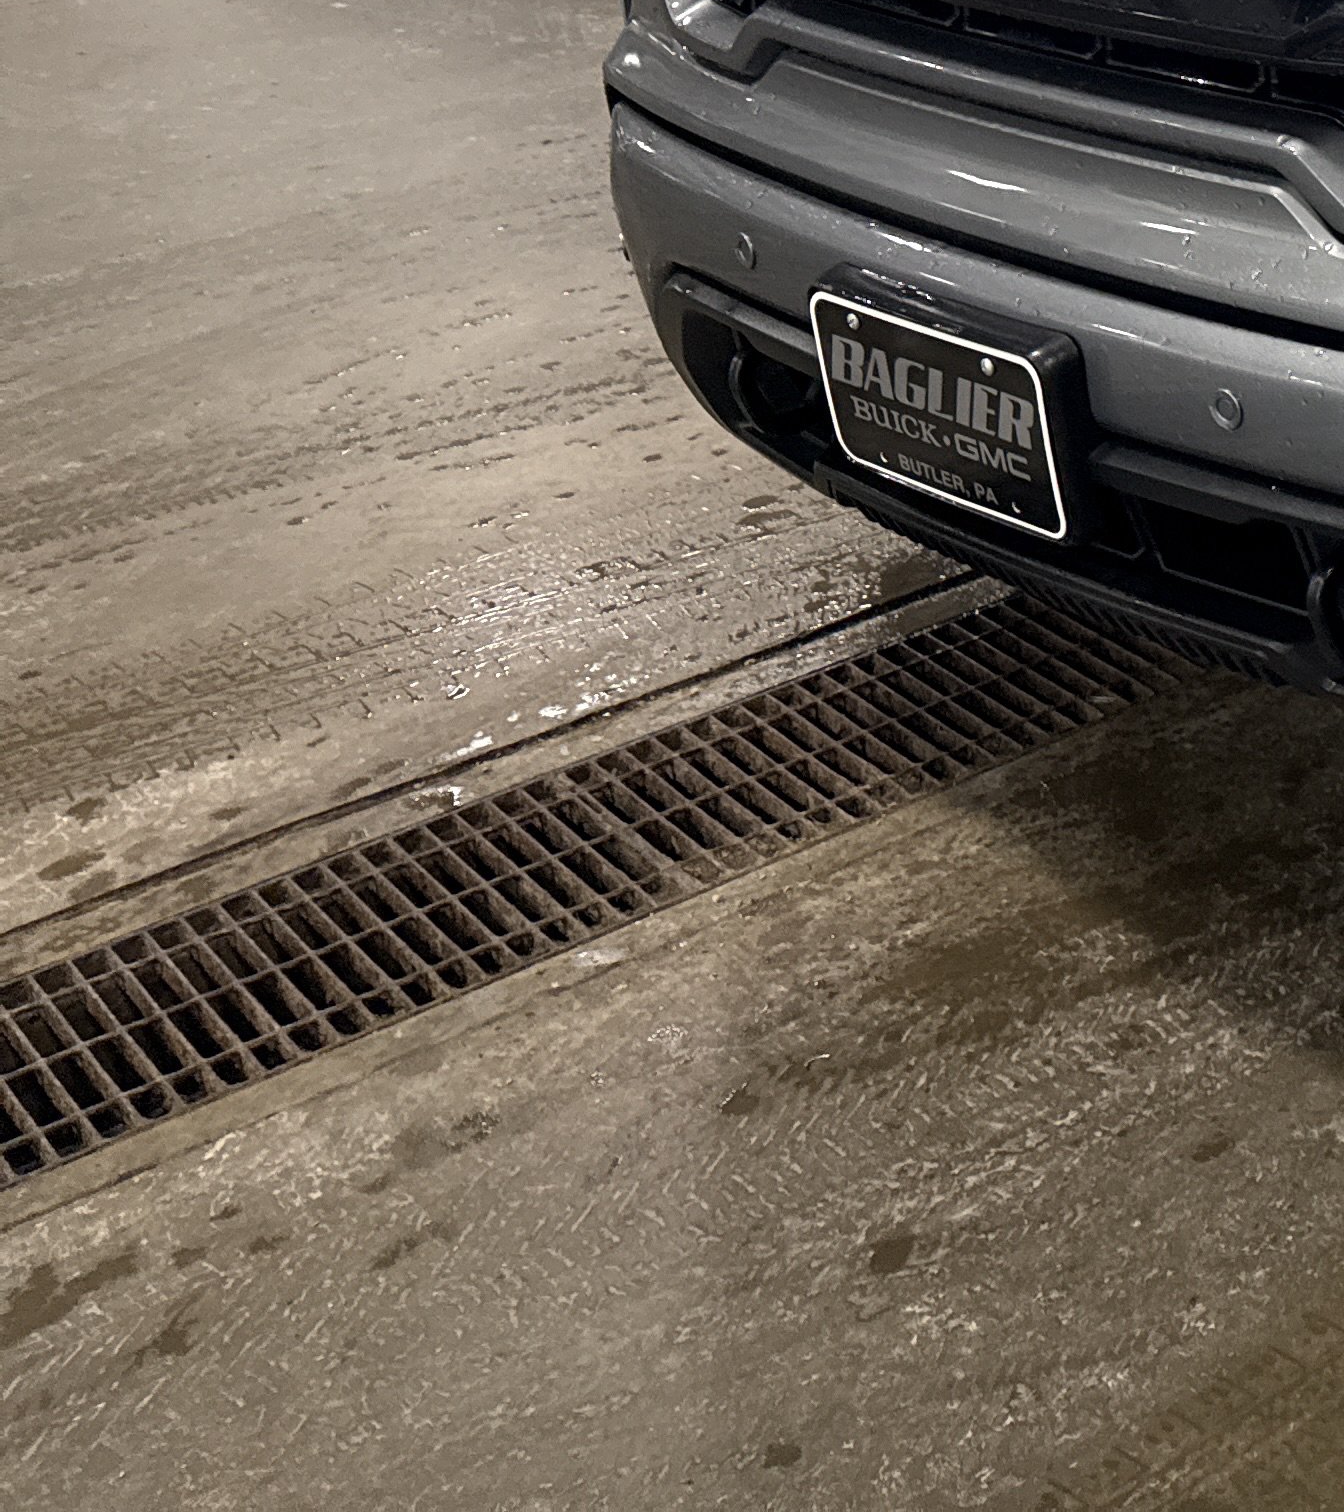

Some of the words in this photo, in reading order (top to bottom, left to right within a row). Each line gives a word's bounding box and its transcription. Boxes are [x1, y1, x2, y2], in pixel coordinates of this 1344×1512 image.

[830, 334, 1035, 450] BAGLIER
[850, 394, 942, 449] BUICK
[953, 432, 1032, 482] GMC
[896, 453, 971, 498] BUTLER,
[974, 481, 1000, 506] PA
